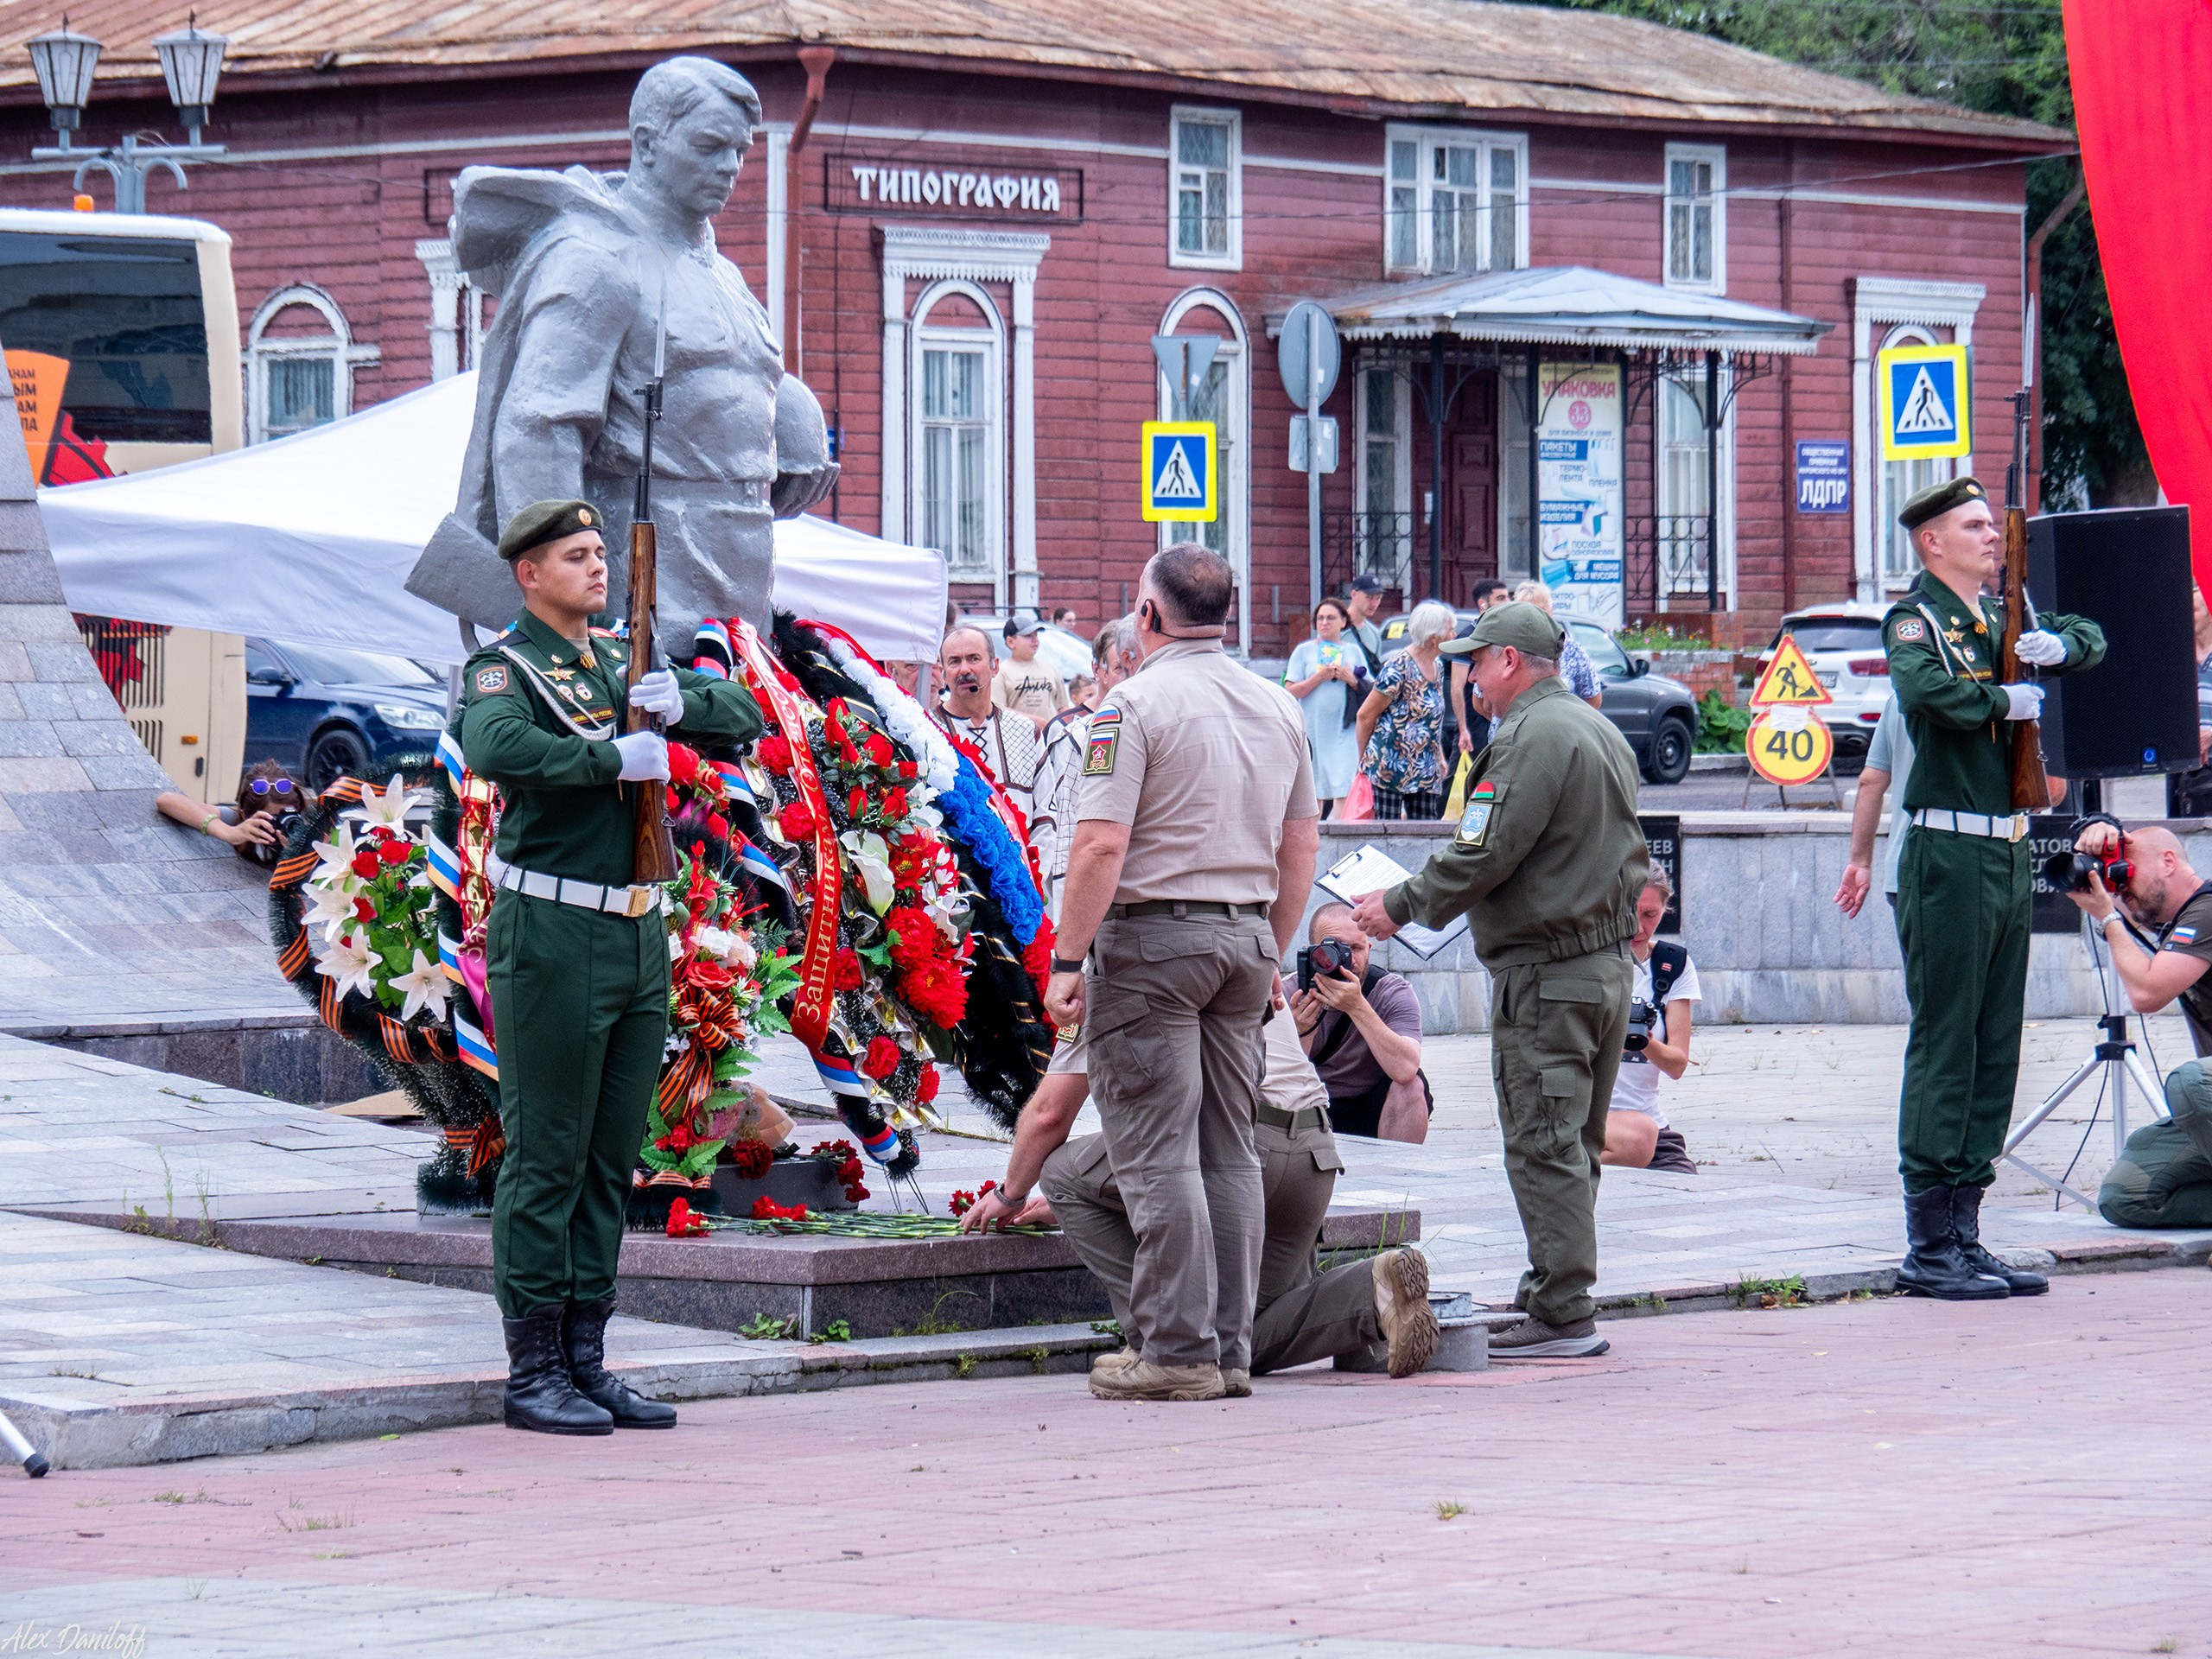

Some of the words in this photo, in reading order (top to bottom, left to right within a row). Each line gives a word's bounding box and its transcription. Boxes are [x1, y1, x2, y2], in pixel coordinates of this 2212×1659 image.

[852, 167, 1060, 212] ТИПОГРАФИЯ
[1540, 442, 1578, 452] ПАКЕТЫ
[1801, 479, 1847, 509] ЛДПР
[1539, 503, 1585, 512] БУМАЖНЫЕ
[1571, 540, 1602, 549] ПОСУДА
[1765, 729, 1814, 761] 40
